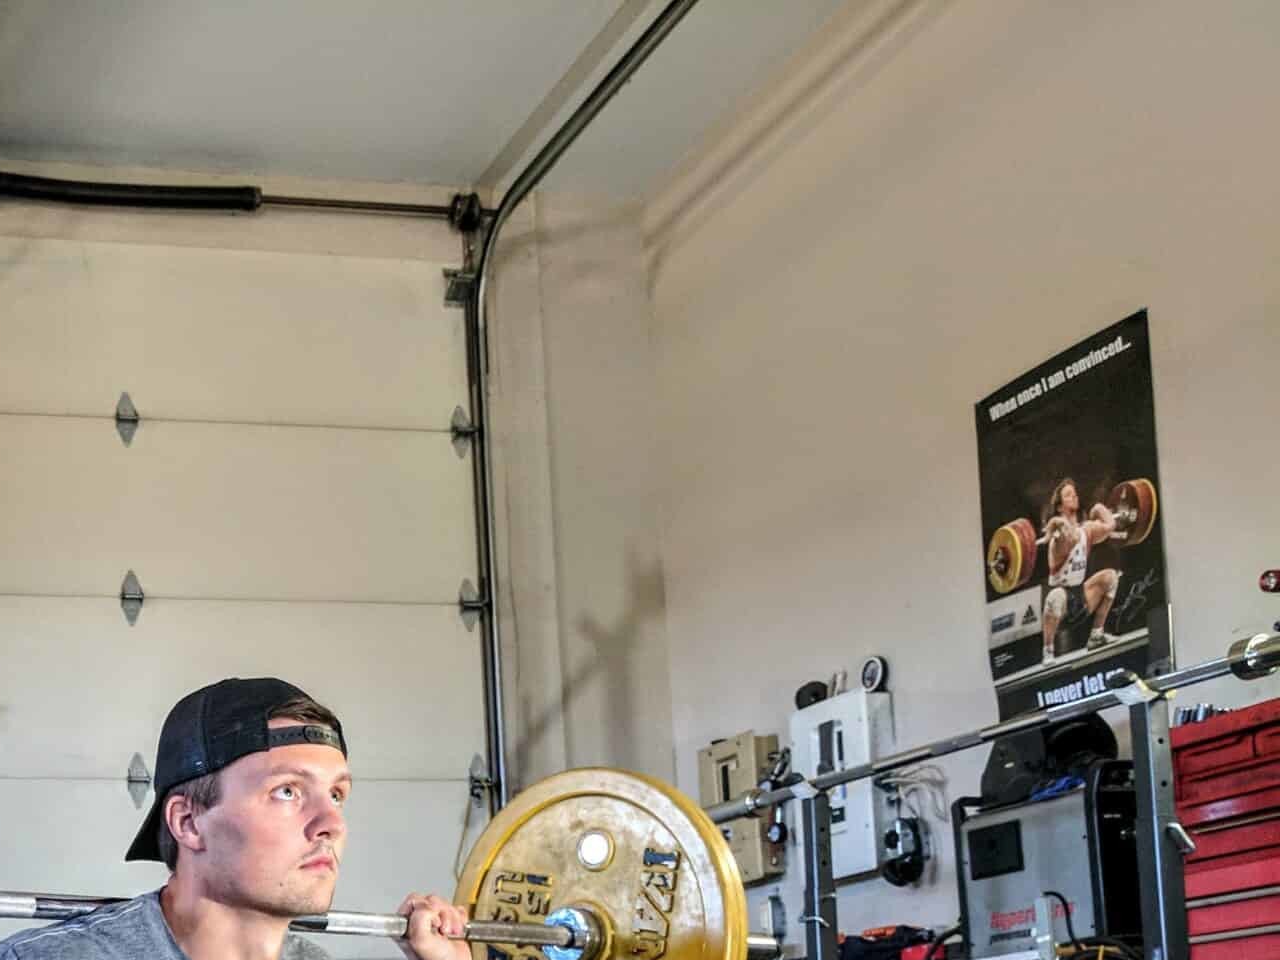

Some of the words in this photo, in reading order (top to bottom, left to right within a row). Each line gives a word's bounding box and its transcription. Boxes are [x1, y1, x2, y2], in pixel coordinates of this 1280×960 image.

[989, 397, 1017, 421] When
[1017, 382, 1043, 405] once
[1041, 377, 1049, 392] I
[1047, 370, 1066, 389] am
[1037, 691, 1045, 708] I
[1044, 681, 1083, 704] never
[1082, 672, 1107, 696] let
